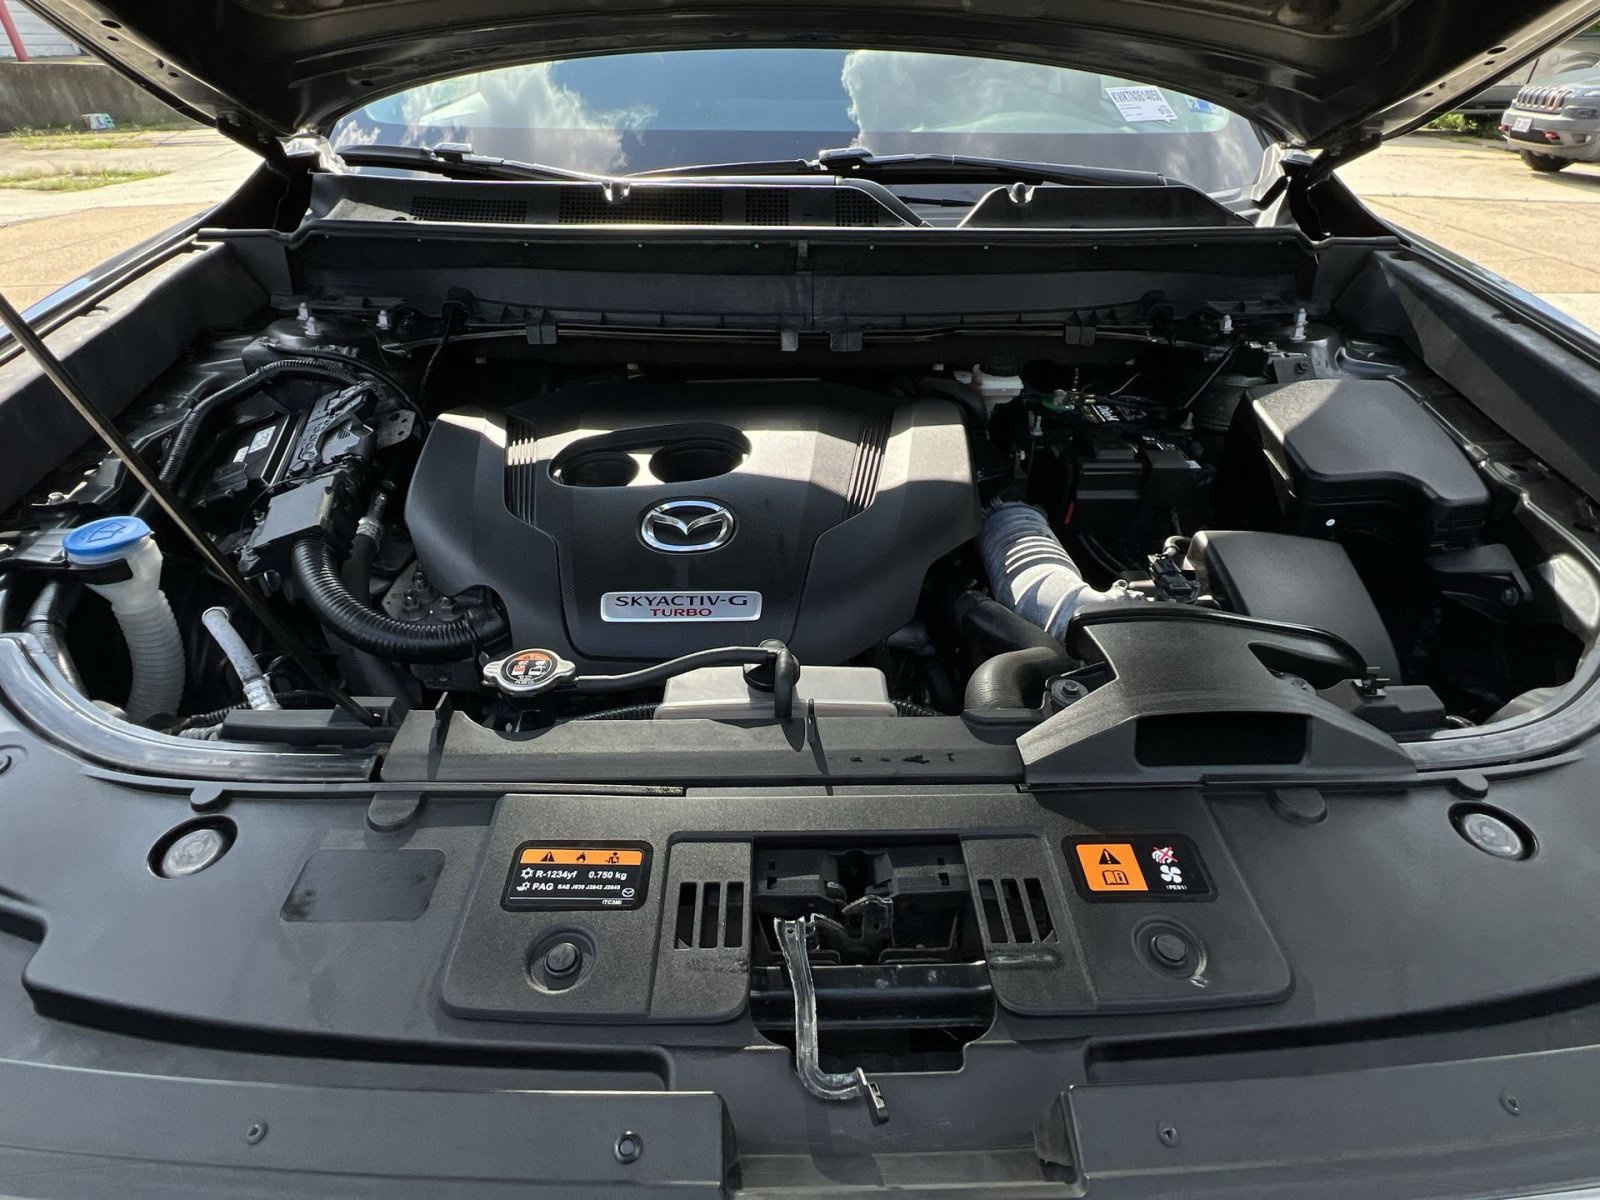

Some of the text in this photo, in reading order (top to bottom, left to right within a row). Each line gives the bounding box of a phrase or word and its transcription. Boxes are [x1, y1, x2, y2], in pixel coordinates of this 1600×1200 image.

[615, 595, 748, 607] SKYACTIV-G
[650, 608, 713, 617] TURBO
[535, 869, 628, 880] R-1234yf 0.750 kg
[532, 882, 554, 891] PAG
